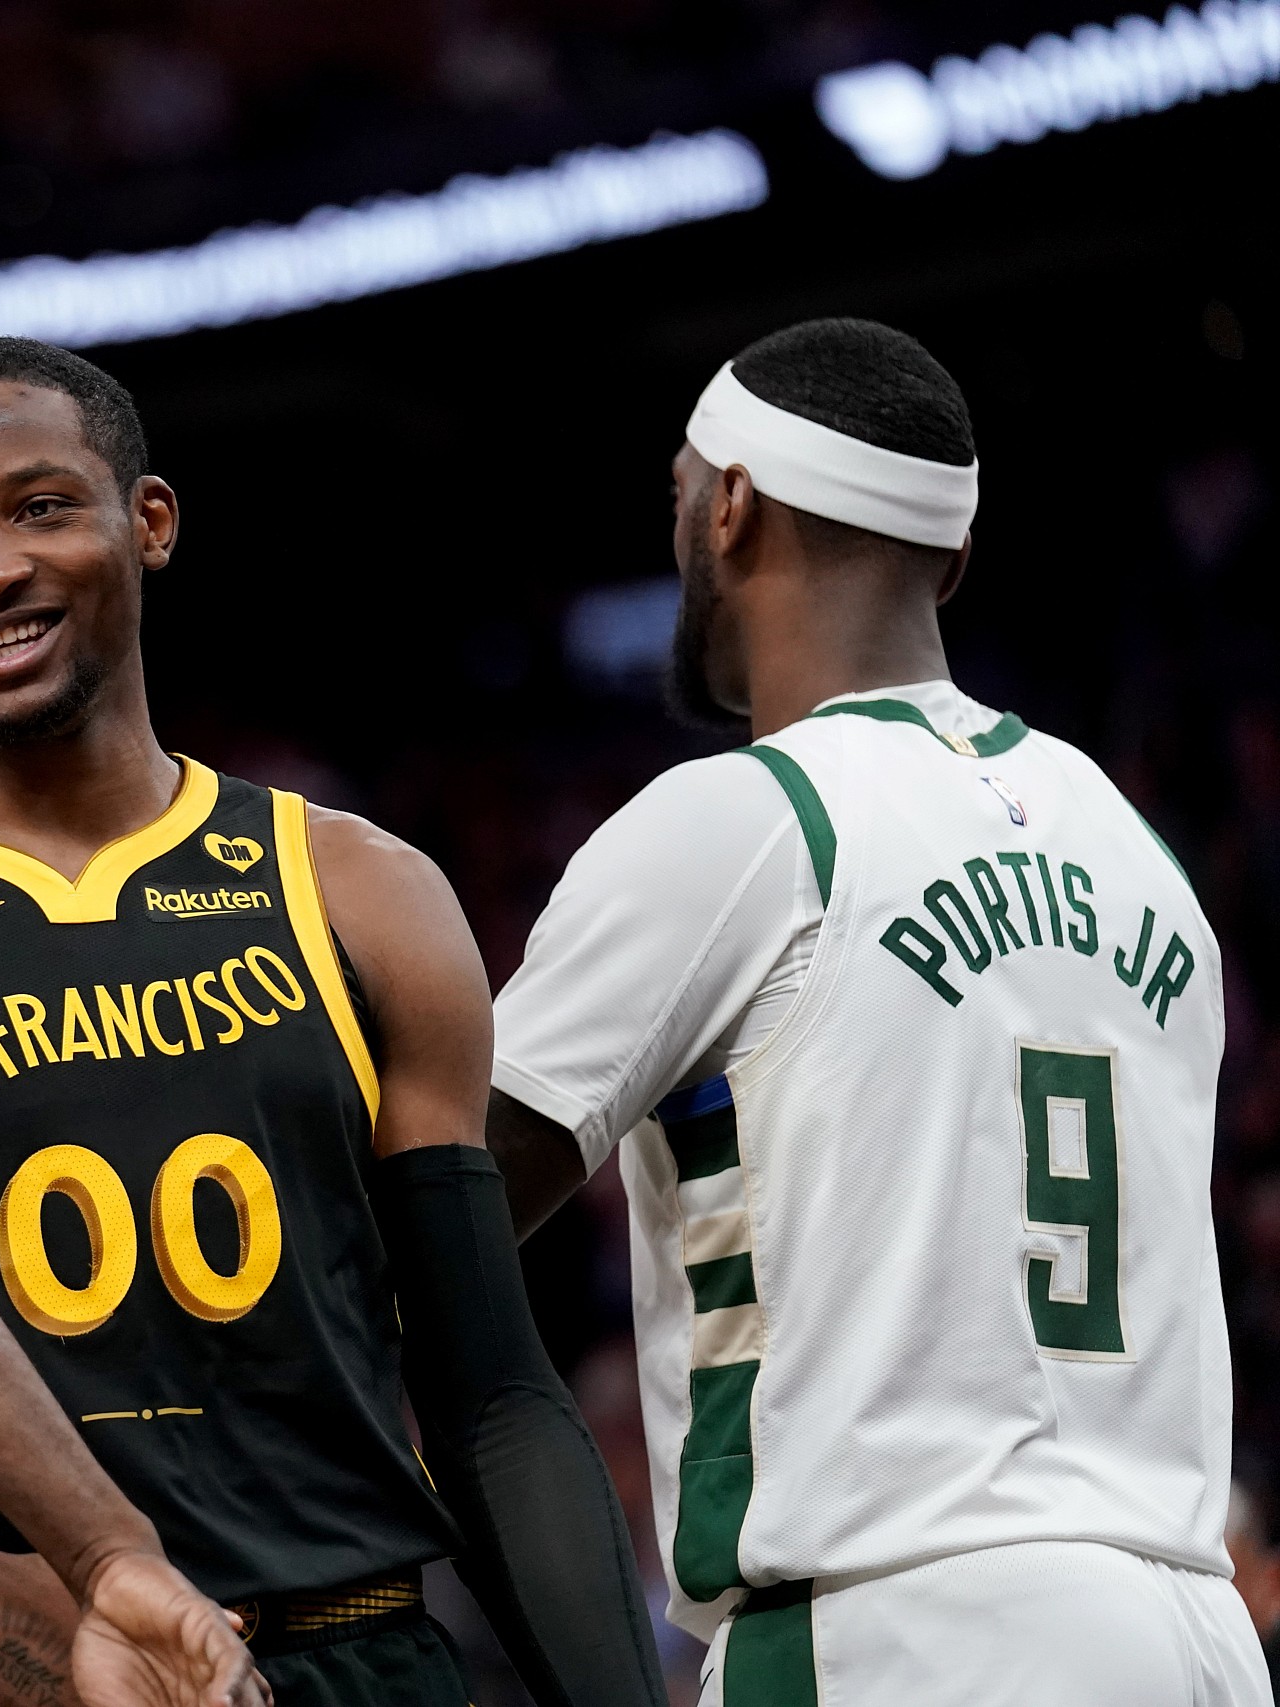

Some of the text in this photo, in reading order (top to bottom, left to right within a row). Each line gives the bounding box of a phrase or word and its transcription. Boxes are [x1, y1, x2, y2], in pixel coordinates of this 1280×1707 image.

[144, 887, 272, 912] Rakuten
[218, 843, 254, 862] DM
[879, 852, 1195, 1030] PORTIS JR
[1015, 1036, 1138, 1364] 9
